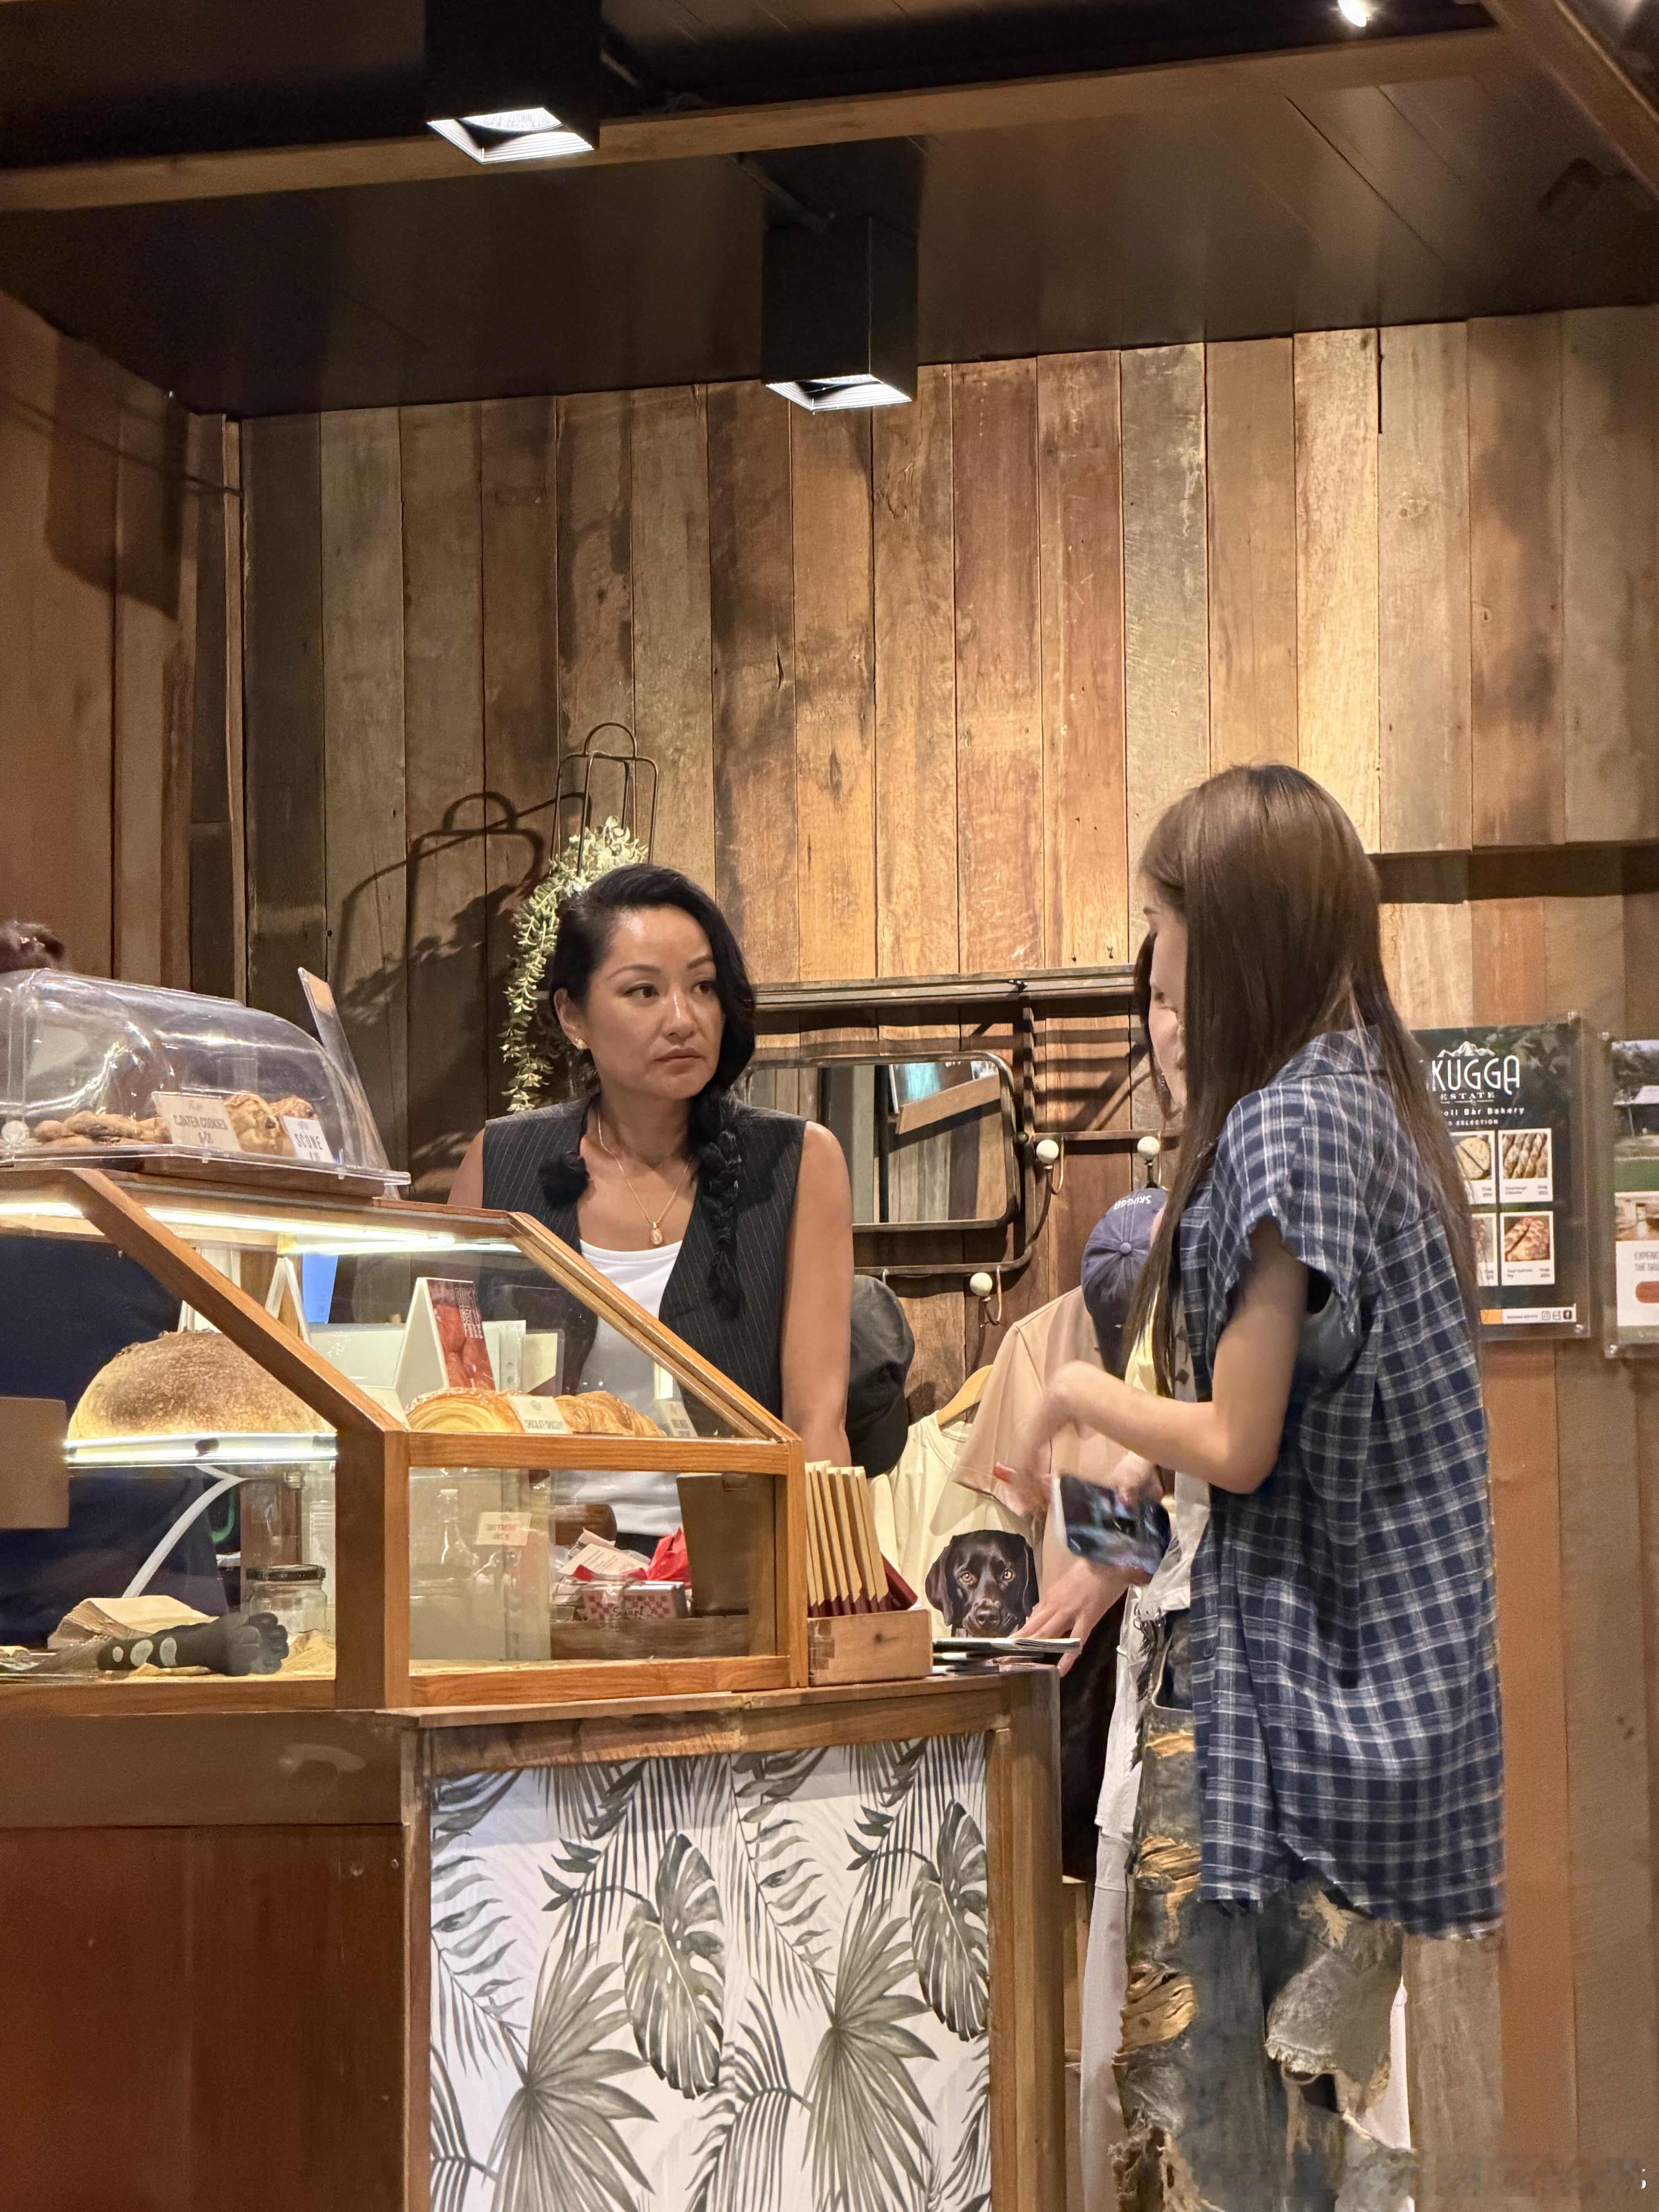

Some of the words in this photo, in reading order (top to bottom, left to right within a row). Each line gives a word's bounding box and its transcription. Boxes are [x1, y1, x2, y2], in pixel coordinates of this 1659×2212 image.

[1425, 1055, 1520, 1095] KUGGA
[1440, 1091, 1495, 1100] ESTATE
[1464, 1107, 1481, 1116] Bar
[1487, 1107, 1525, 1116] Bakery
[294, 1133, 323, 1150] SCONE
[1113, 1195, 1152, 1210] SKUGGA
